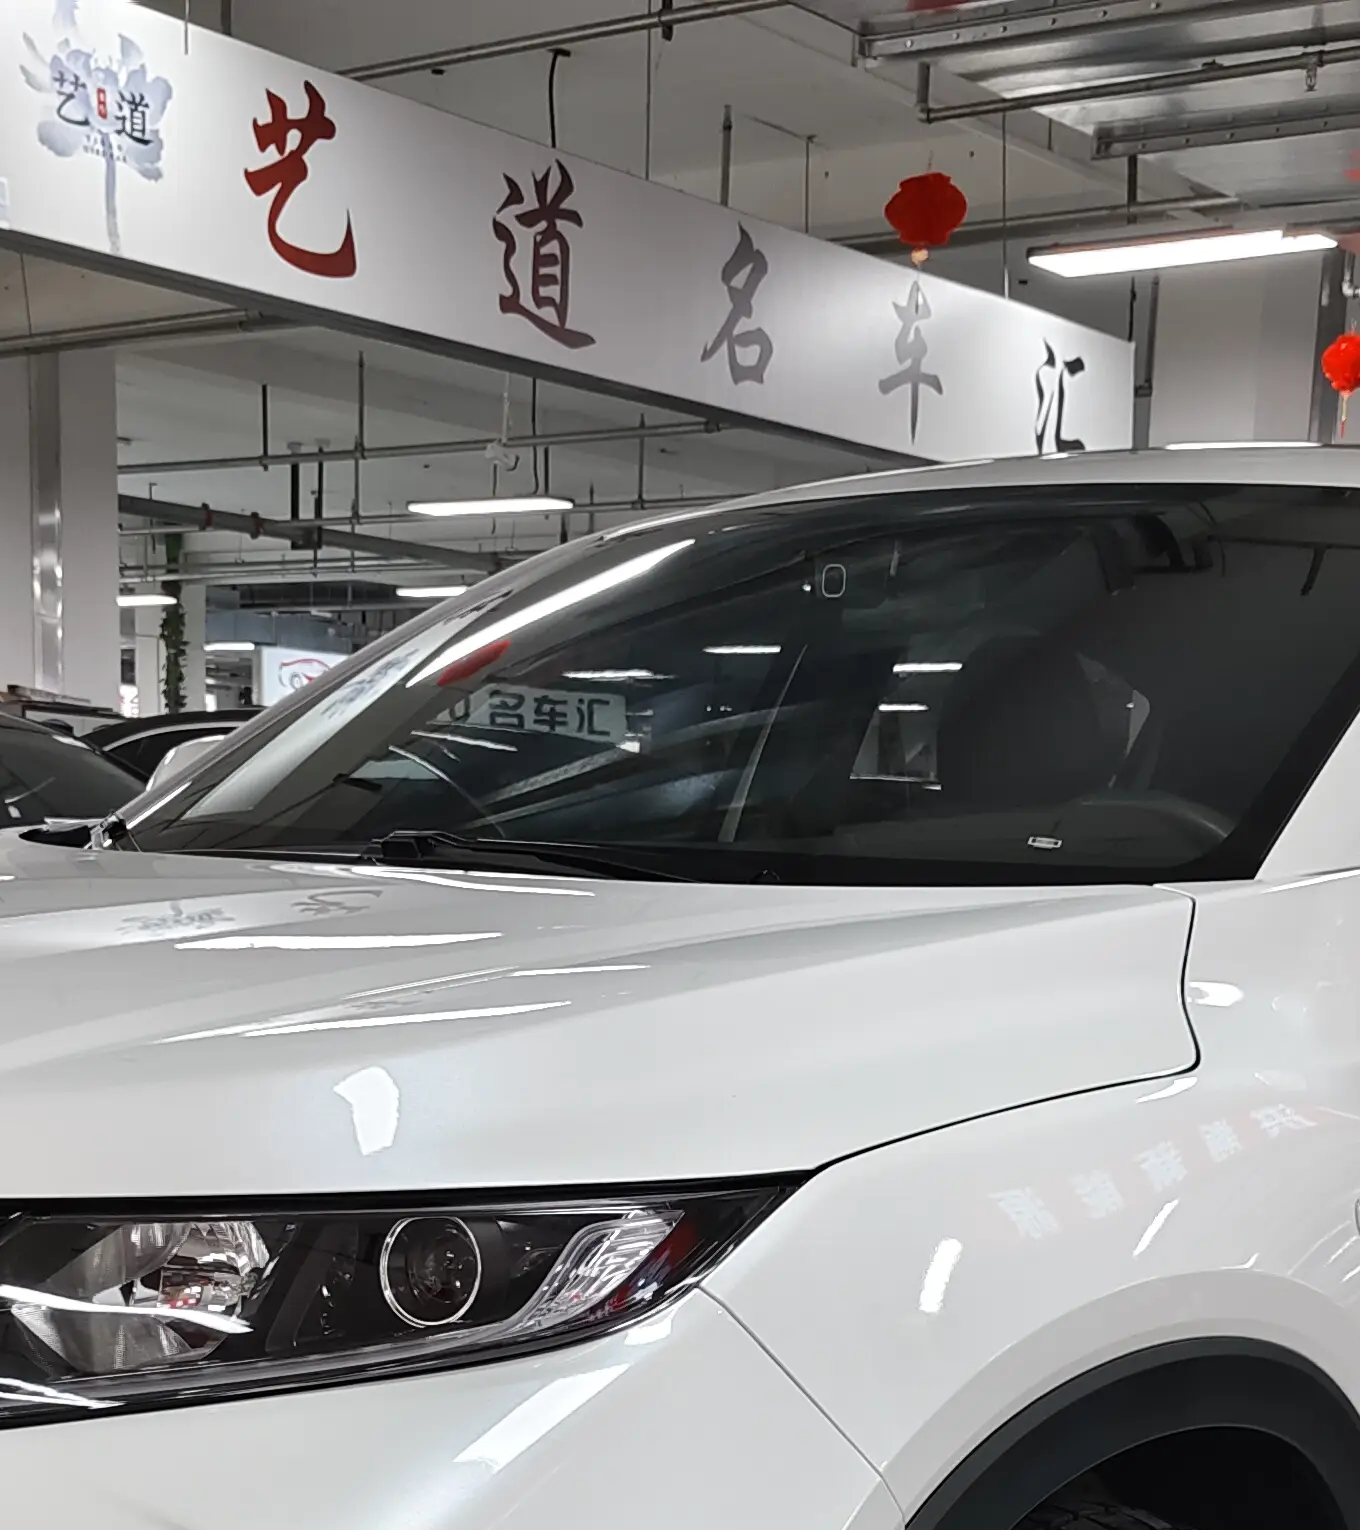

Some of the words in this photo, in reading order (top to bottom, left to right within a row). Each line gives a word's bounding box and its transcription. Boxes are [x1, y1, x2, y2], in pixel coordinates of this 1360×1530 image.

[52, 70, 154, 146] 艺道
[244, 79, 1086, 454] 艺道名车汇
